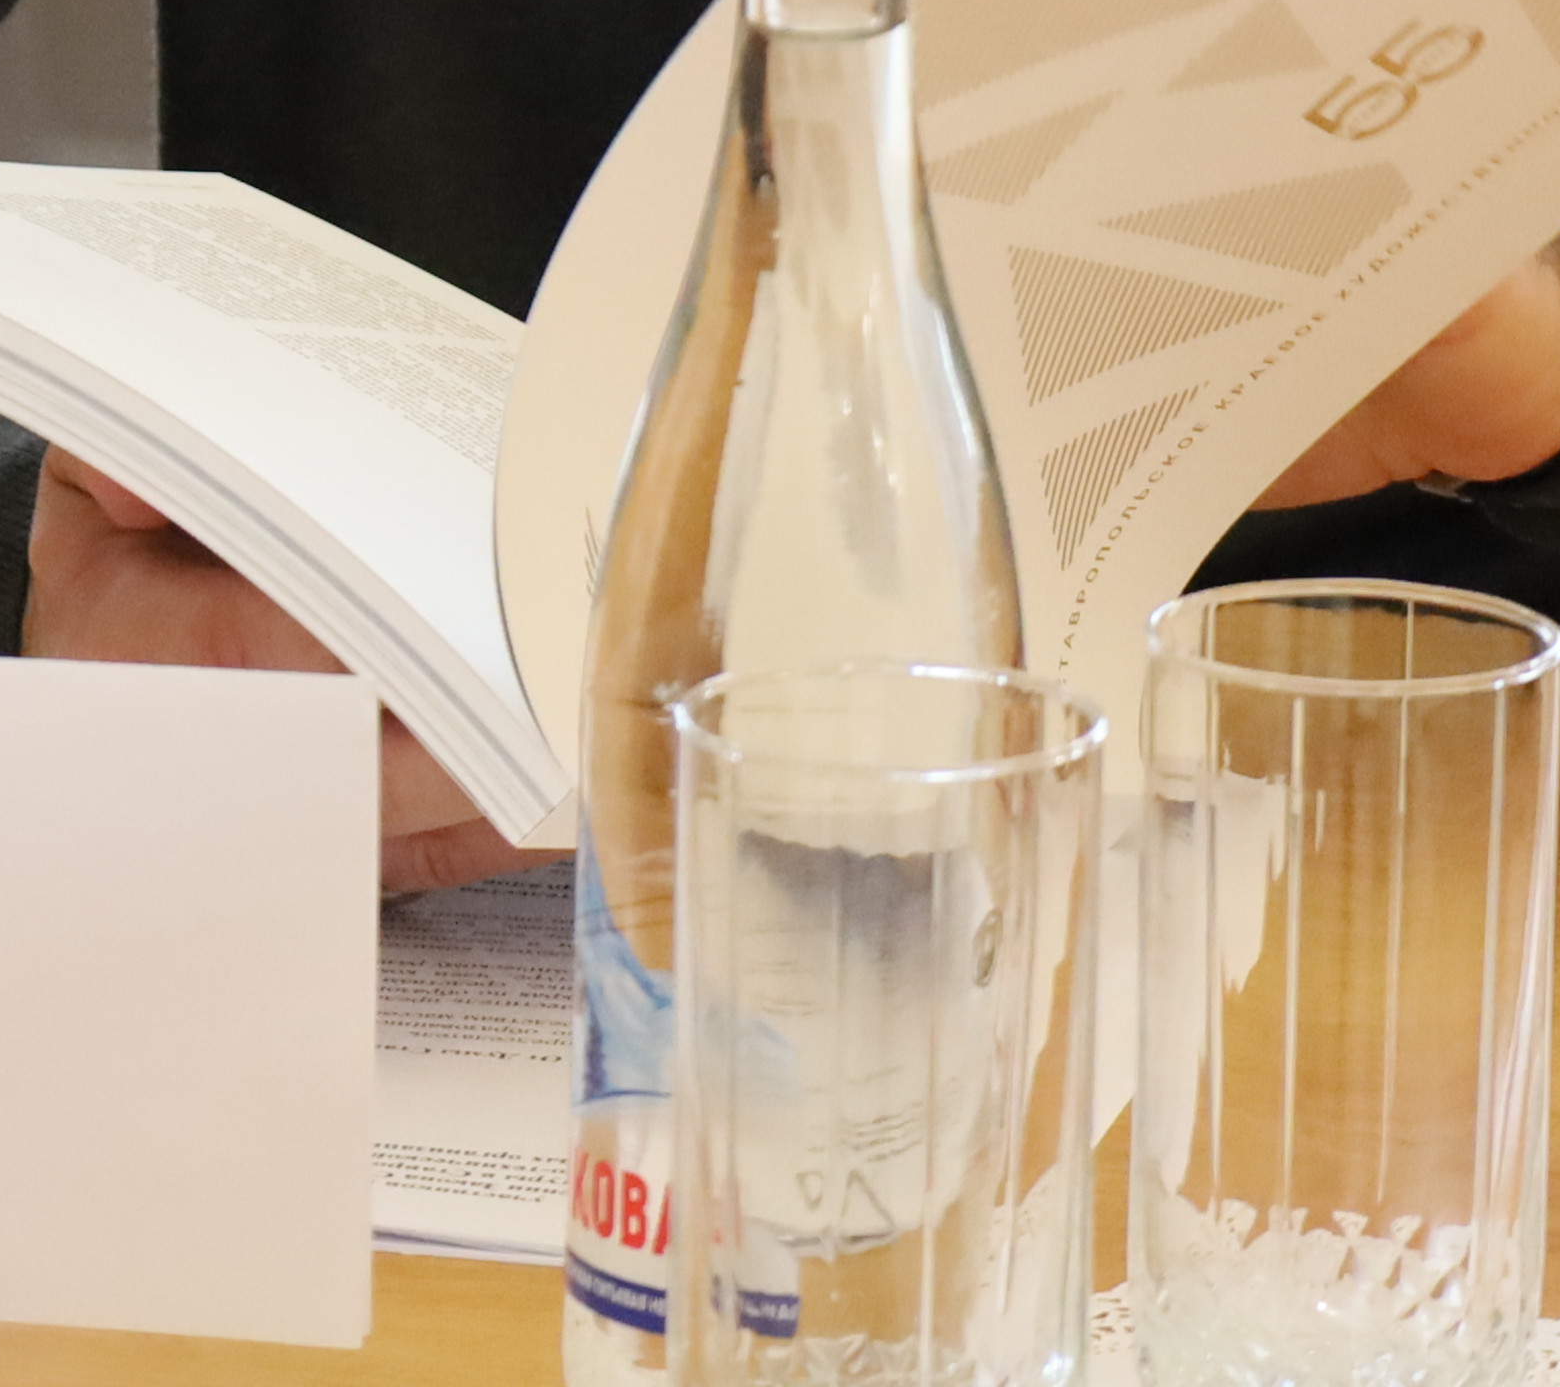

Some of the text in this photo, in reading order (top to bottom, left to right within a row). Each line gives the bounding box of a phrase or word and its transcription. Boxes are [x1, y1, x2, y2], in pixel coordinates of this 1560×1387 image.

[1303, 21, 1485, 141] 55
[1057, 419, 1211, 684] ТАВРОПОЛЬСКОЕ
[1214, 311, 1327, 411] КРАЕВОЕ
